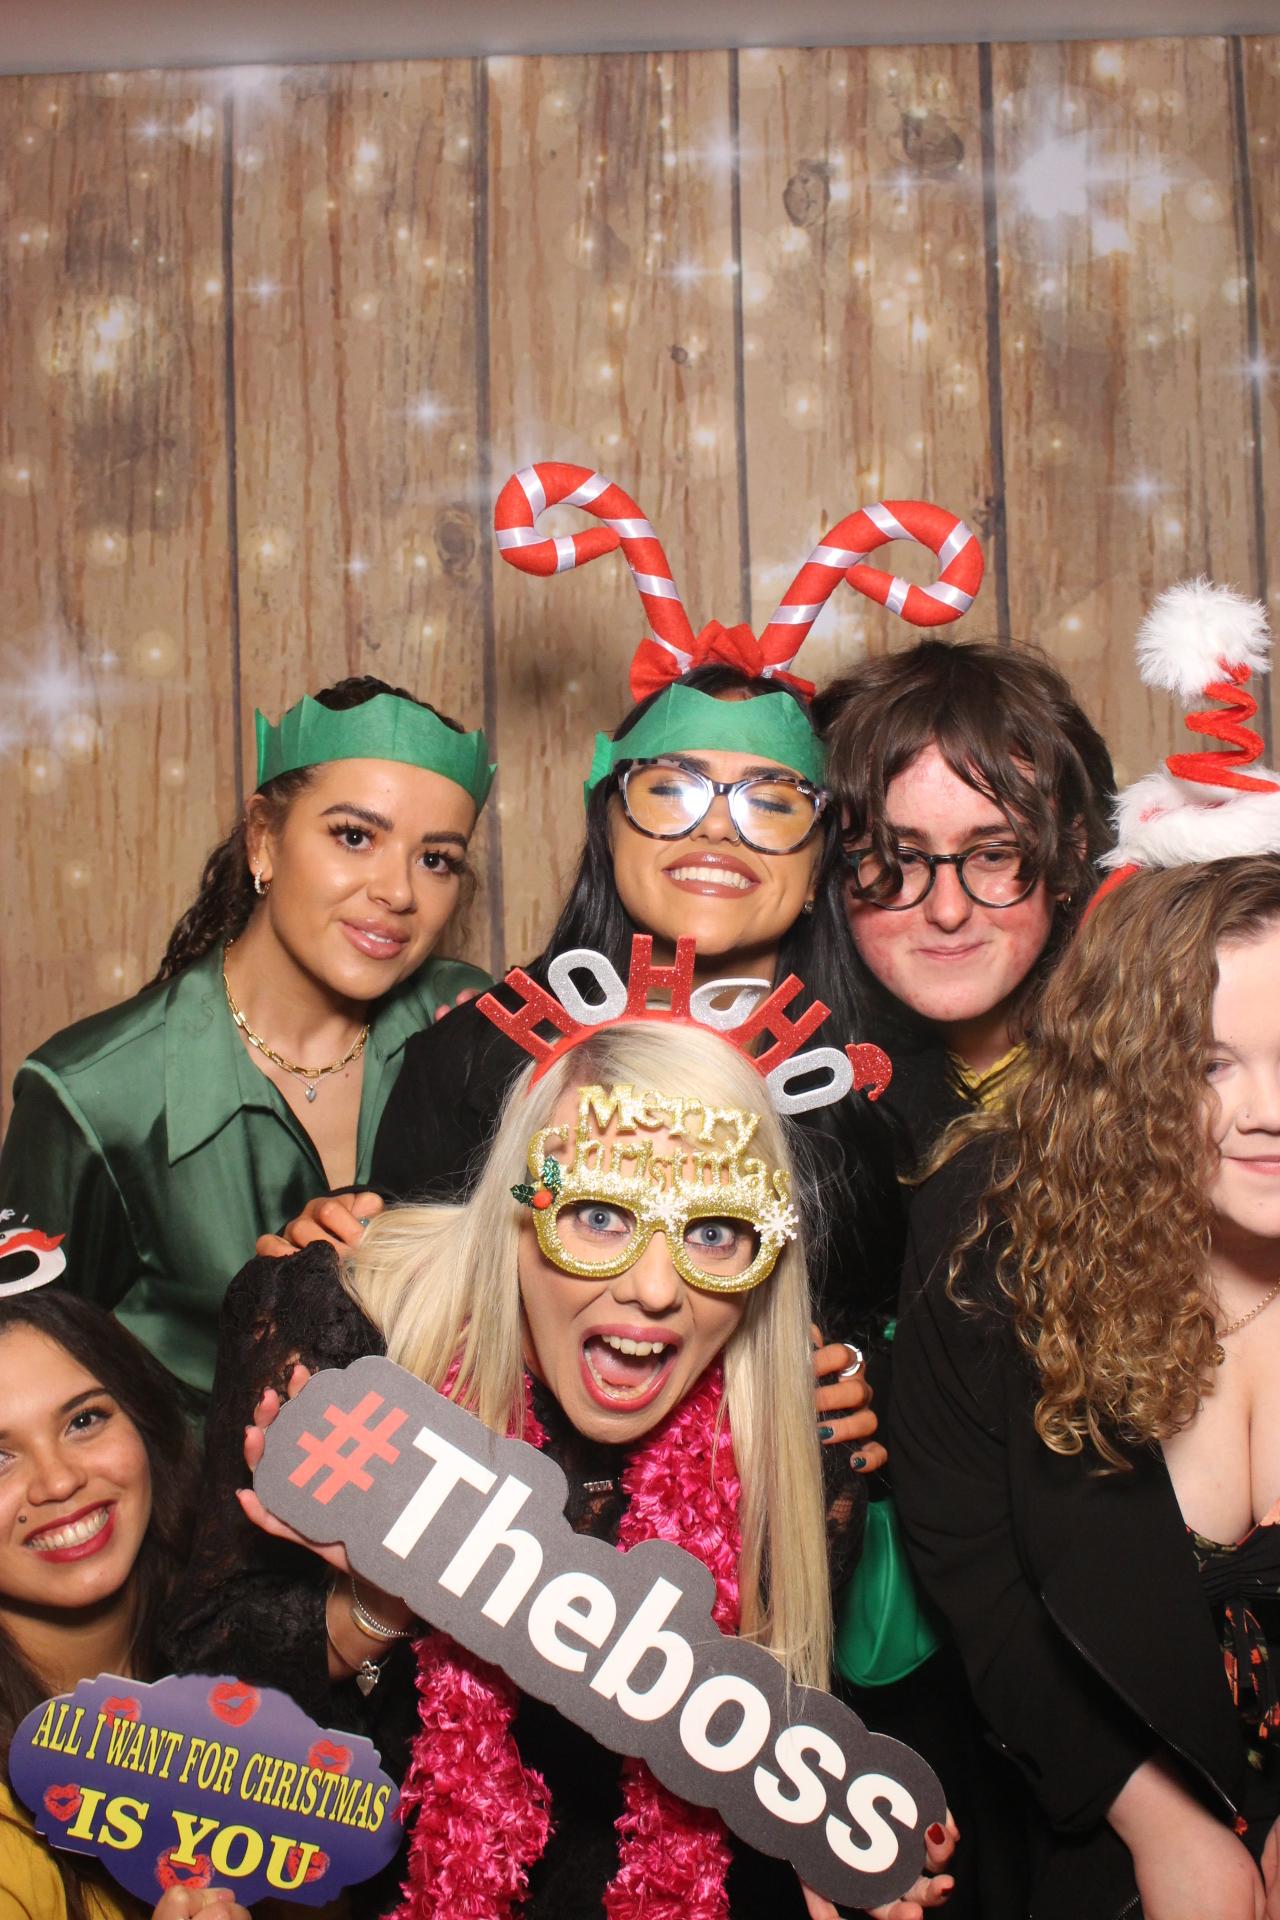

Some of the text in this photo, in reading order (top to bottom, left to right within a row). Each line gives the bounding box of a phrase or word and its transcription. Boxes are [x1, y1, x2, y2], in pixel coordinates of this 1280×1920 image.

[527, 1124, 791, 1203] Christmas
[577, 1084, 761, 1154] Merry
[288, 1391, 919, 1874] #Theboss
[31, 1700, 392, 1833] ALL I WANT FOR CHRISTMAS
[66, 1787, 320, 1890] IS YOU
